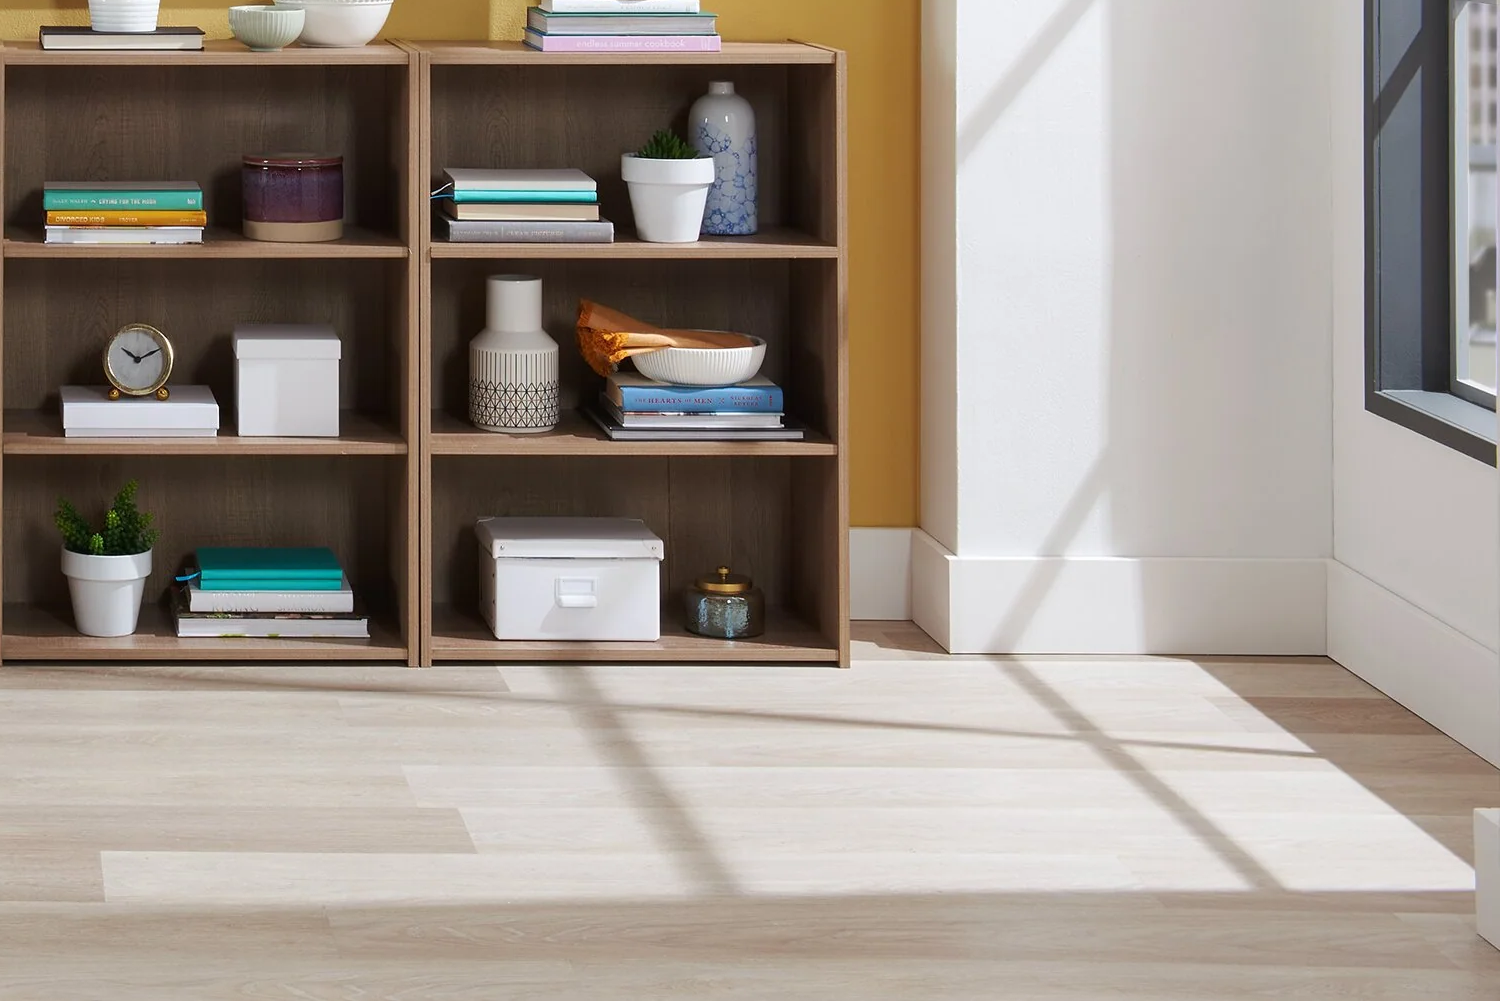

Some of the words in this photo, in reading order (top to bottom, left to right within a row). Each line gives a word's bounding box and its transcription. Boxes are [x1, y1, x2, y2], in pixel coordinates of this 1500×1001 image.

[577, 38, 608, 48] endless
[609, 40, 642, 48] summer
[644, 38, 686, 48] cookbook
